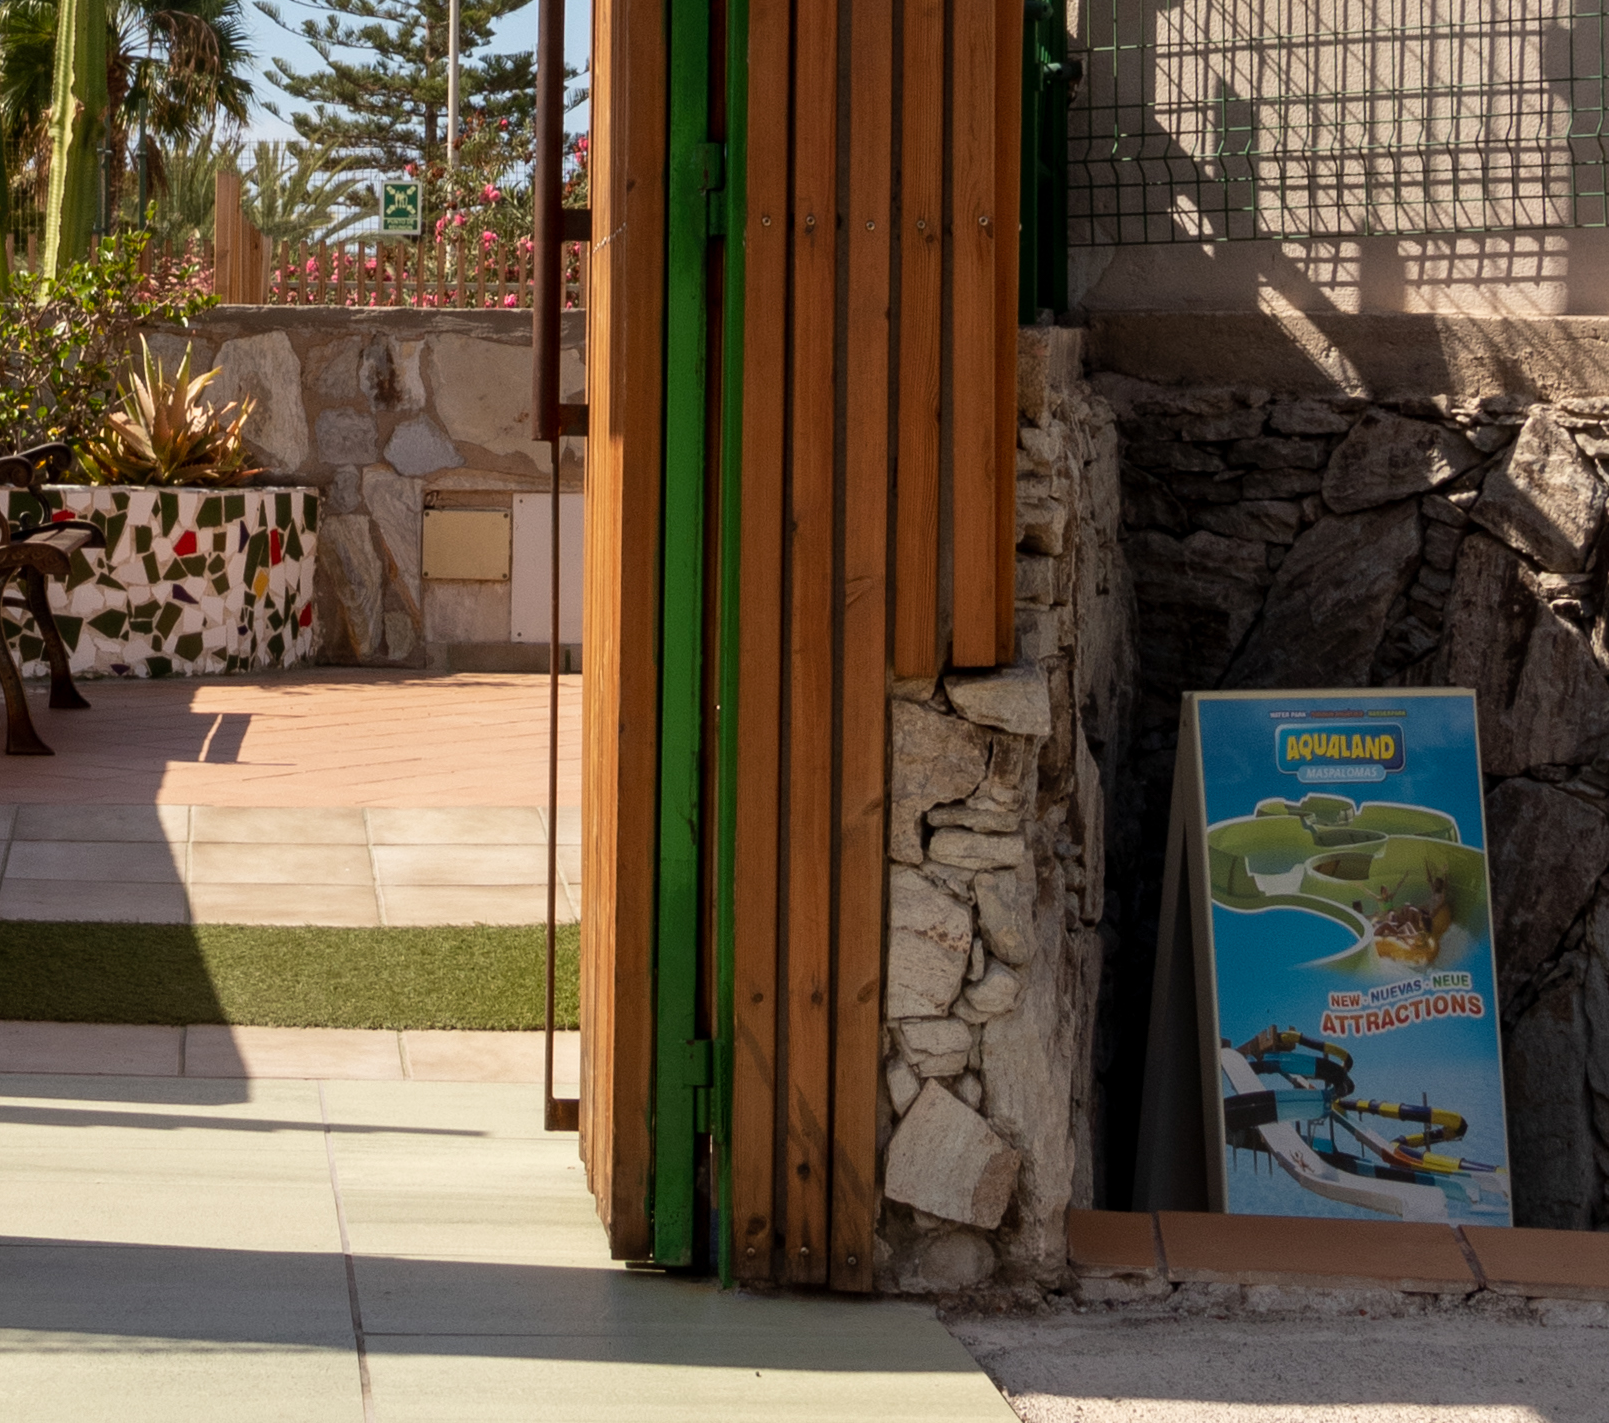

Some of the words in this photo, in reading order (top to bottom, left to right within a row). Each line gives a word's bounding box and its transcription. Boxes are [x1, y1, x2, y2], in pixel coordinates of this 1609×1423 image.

[1286, 733, 1395, 761] AQUALAND
[1305, 766, 1377, 779] MASPALOMAS
[1330, 994, 1360, 1007] NEW
[1370, 980, 1422, 1003] NUEVAS
[1432, 974, 1469, 988] NEUE
[1322, 994, 1483, 1035] ATTRACTIONS
